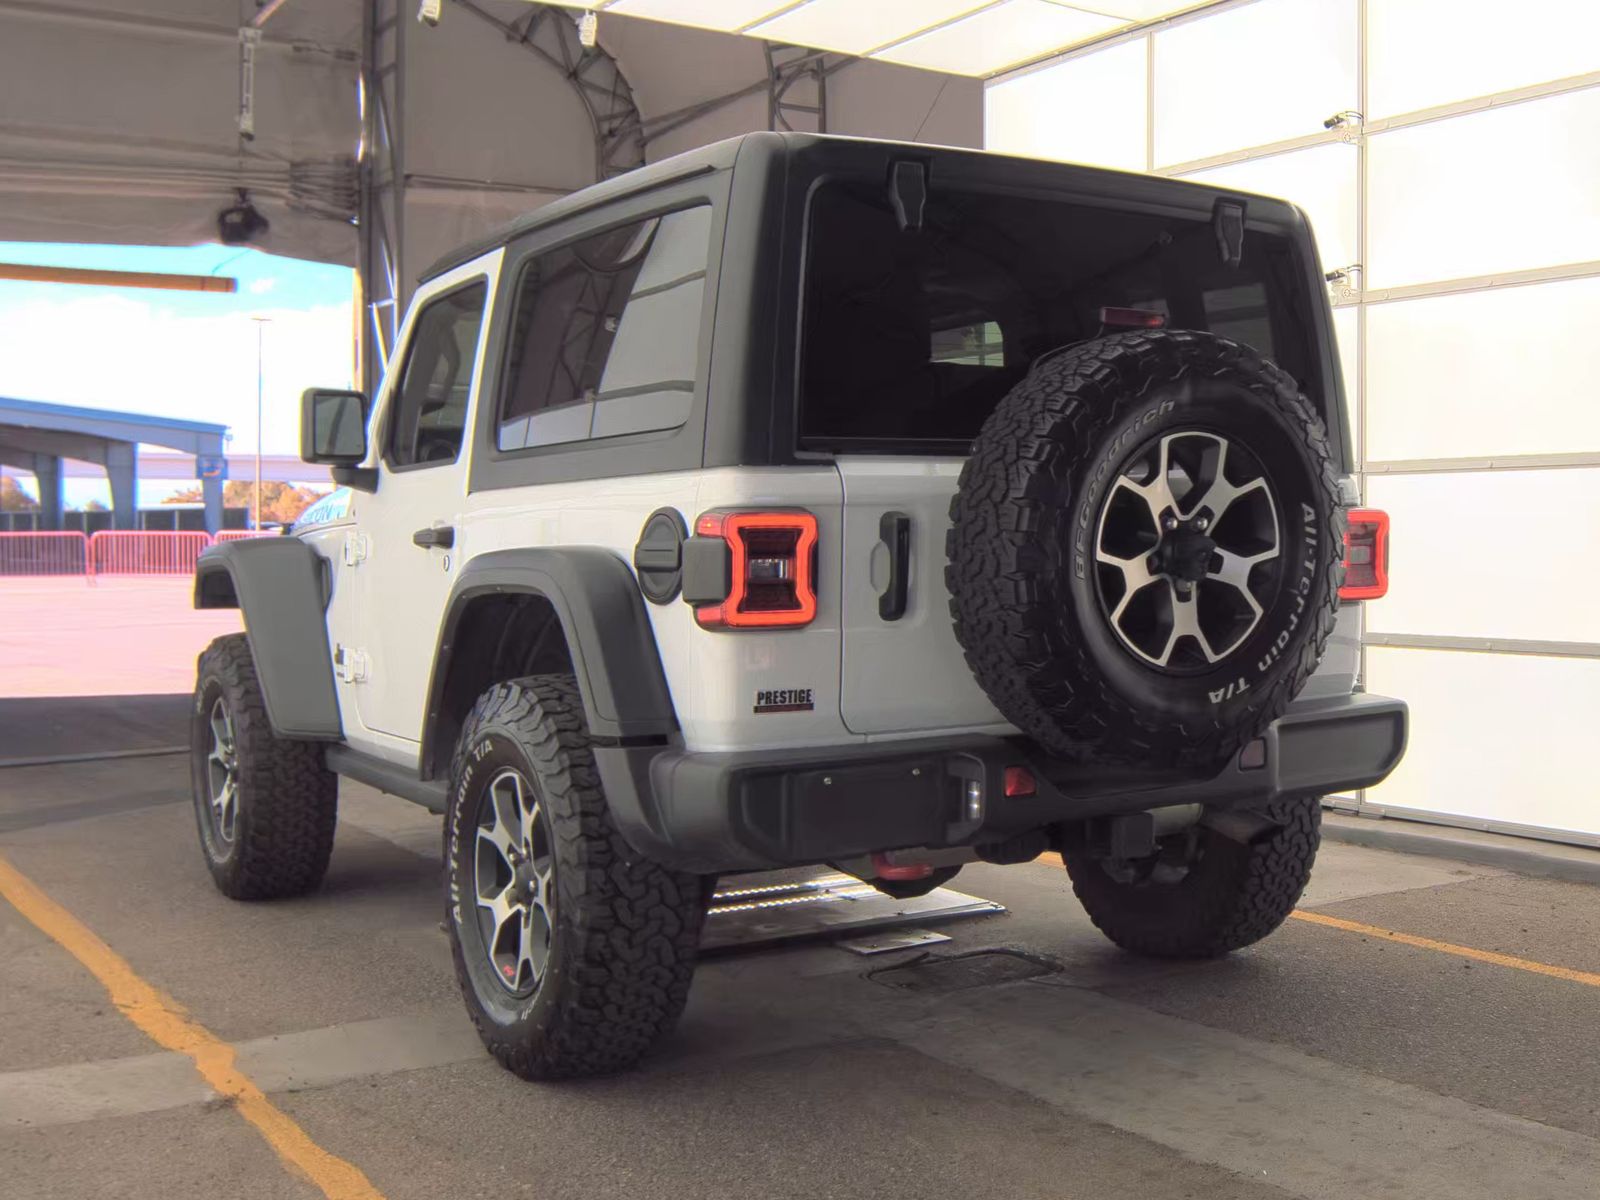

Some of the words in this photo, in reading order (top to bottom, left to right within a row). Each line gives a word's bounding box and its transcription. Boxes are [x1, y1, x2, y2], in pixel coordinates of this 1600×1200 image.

[1073, 399, 1175, 580] BFGoodrich
[1257, 502, 1318, 673] All-Terrain
[756, 688, 813, 705] PRESTIGE
[1208, 676, 1251, 705] T/A
[474, 740, 494, 763] T/A
